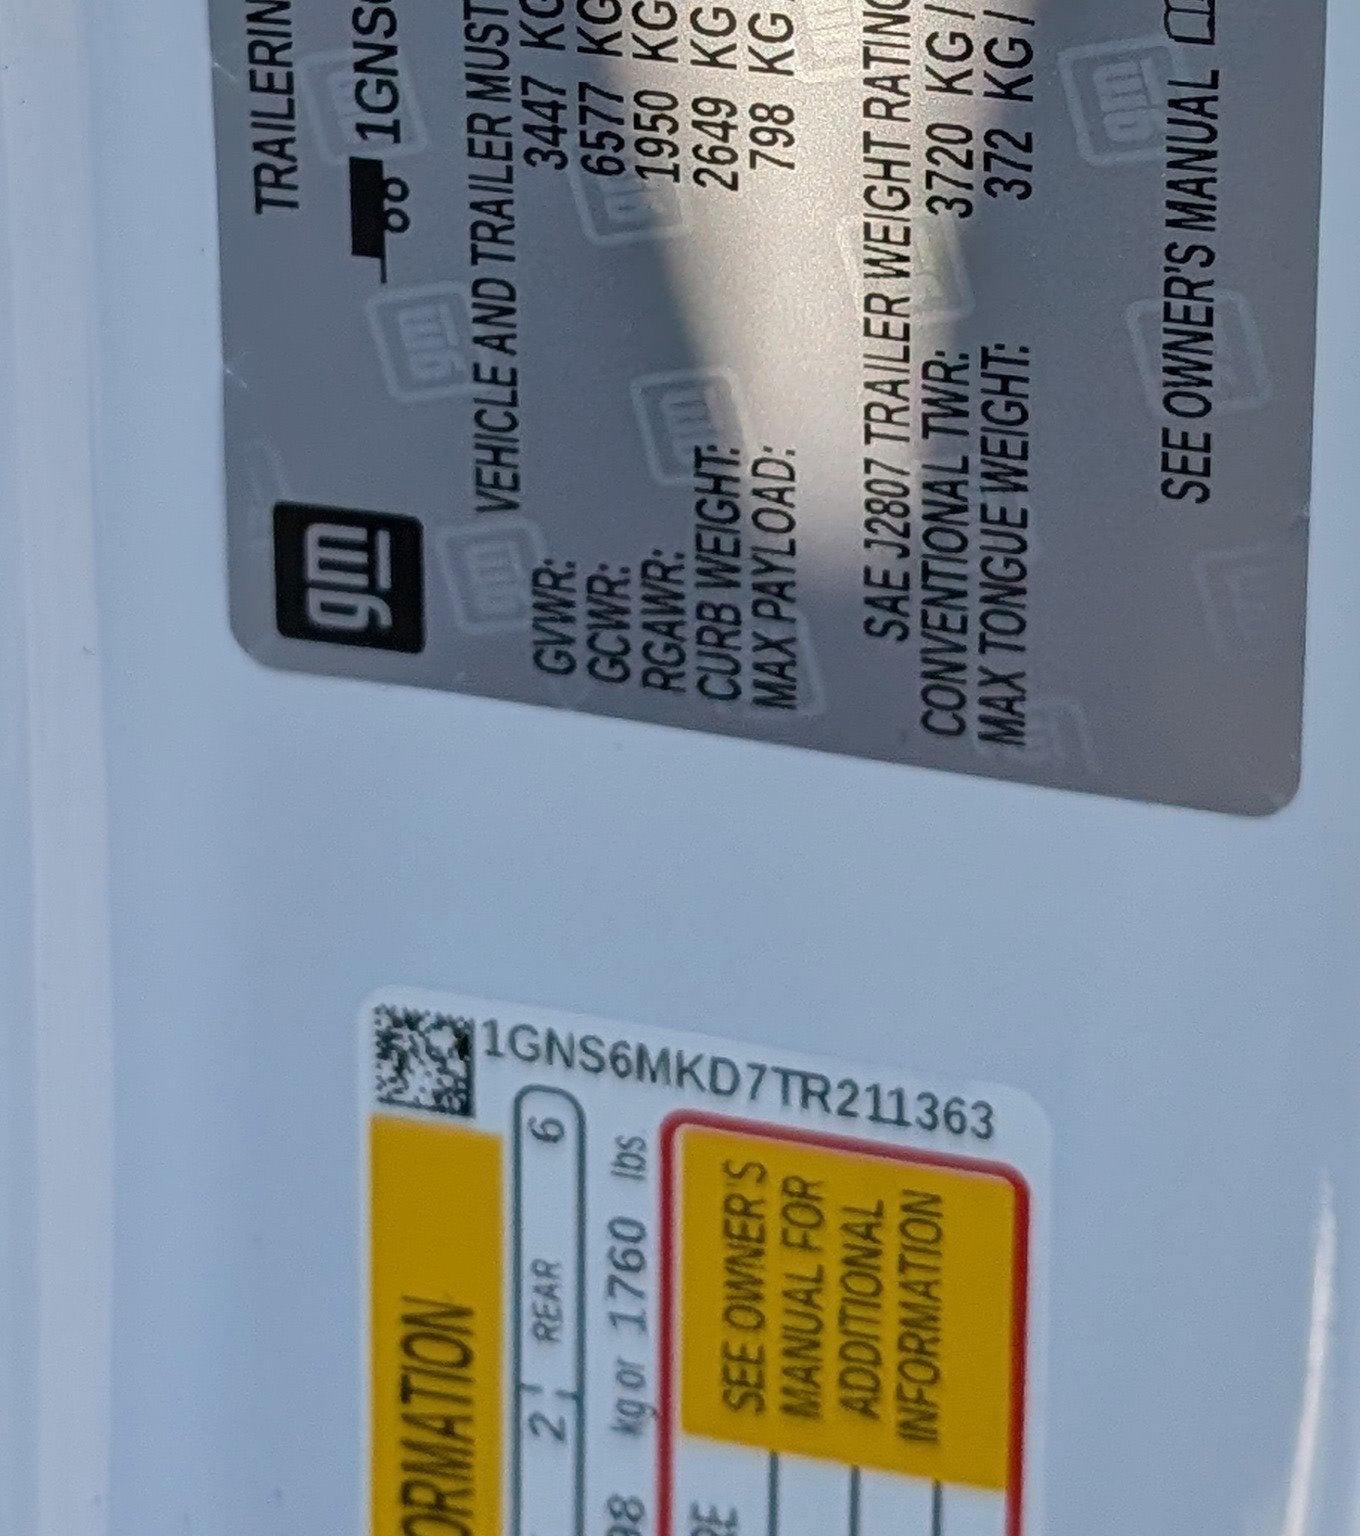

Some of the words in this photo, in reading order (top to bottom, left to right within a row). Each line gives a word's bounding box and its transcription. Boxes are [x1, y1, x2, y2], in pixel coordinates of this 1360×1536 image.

[924, 4, 975, 95] KG/
[983, 10, 1035, 102] KG/
[521, 76, 568, 170] 3447
[578, 82, 626, 176] 6577
[634, 90, 680, 182] 1950
[692, 97, 738, 191] 2649
[749, 103, 795, 170] 798
[925, 123, 973, 218] 3720
[983, 129, 1033, 200] 372
[1165, 70, 1219, 232] MANUAL
[467, 113, 515, 266] TRAILER
[863, 131, 911, 278] WEIGHT
[471, 278, 517, 356] AND
[1162, 242, 1215, 418] OWNER'S
[863, 293, 910, 445] TRAILER
[922, 351, 969, 439] TWR:
[472, 362, 520, 513] VEHICLE
[980, 343, 1029, 492] WEIGHT:
[864, 458, 910, 559] J2807
[1161, 427, 1211, 504] SEE
[694, 445, 741, 588] WEIGHT:
[751, 446, 796, 624] PAYLOAD:
[531, 559, 576, 675] GVWR:
[586, 564, 631, 683] GCWR:
[641, 549, 685, 693] RGAWR:
[864, 566, 910, 642] SAE
[920, 456, 969, 737] CONVENTIONAL
[979, 503, 1028, 654] TONGUE
[696, 601, 742, 701] CURB
[752, 632, 797, 710] MAX
[978, 666, 1026, 747] MAX
[483, 1018, 996, 1141] 1GNS6MKD7TR211363
[527, 1116, 565, 1144] 6
[610, 1134, 648, 1182] lbs
[722, 1159, 768, 1331] OWNER'S
[781, 1174, 826, 1252] FOR
[531, 1258, 563, 1342] REAR
[606, 1215, 647, 1334] 1760
[838, 1198, 885, 1421] ADDITIONAL
[897, 1189, 943, 1445] INFORMATION
[614, 1356, 645, 1390] or
[720, 1341, 764, 1414] SEE
[780, 1264, 825, 1421] MANUAL
[528, 1411, 566, 1444] 2
[611, 1396, 658, 1436] kg
